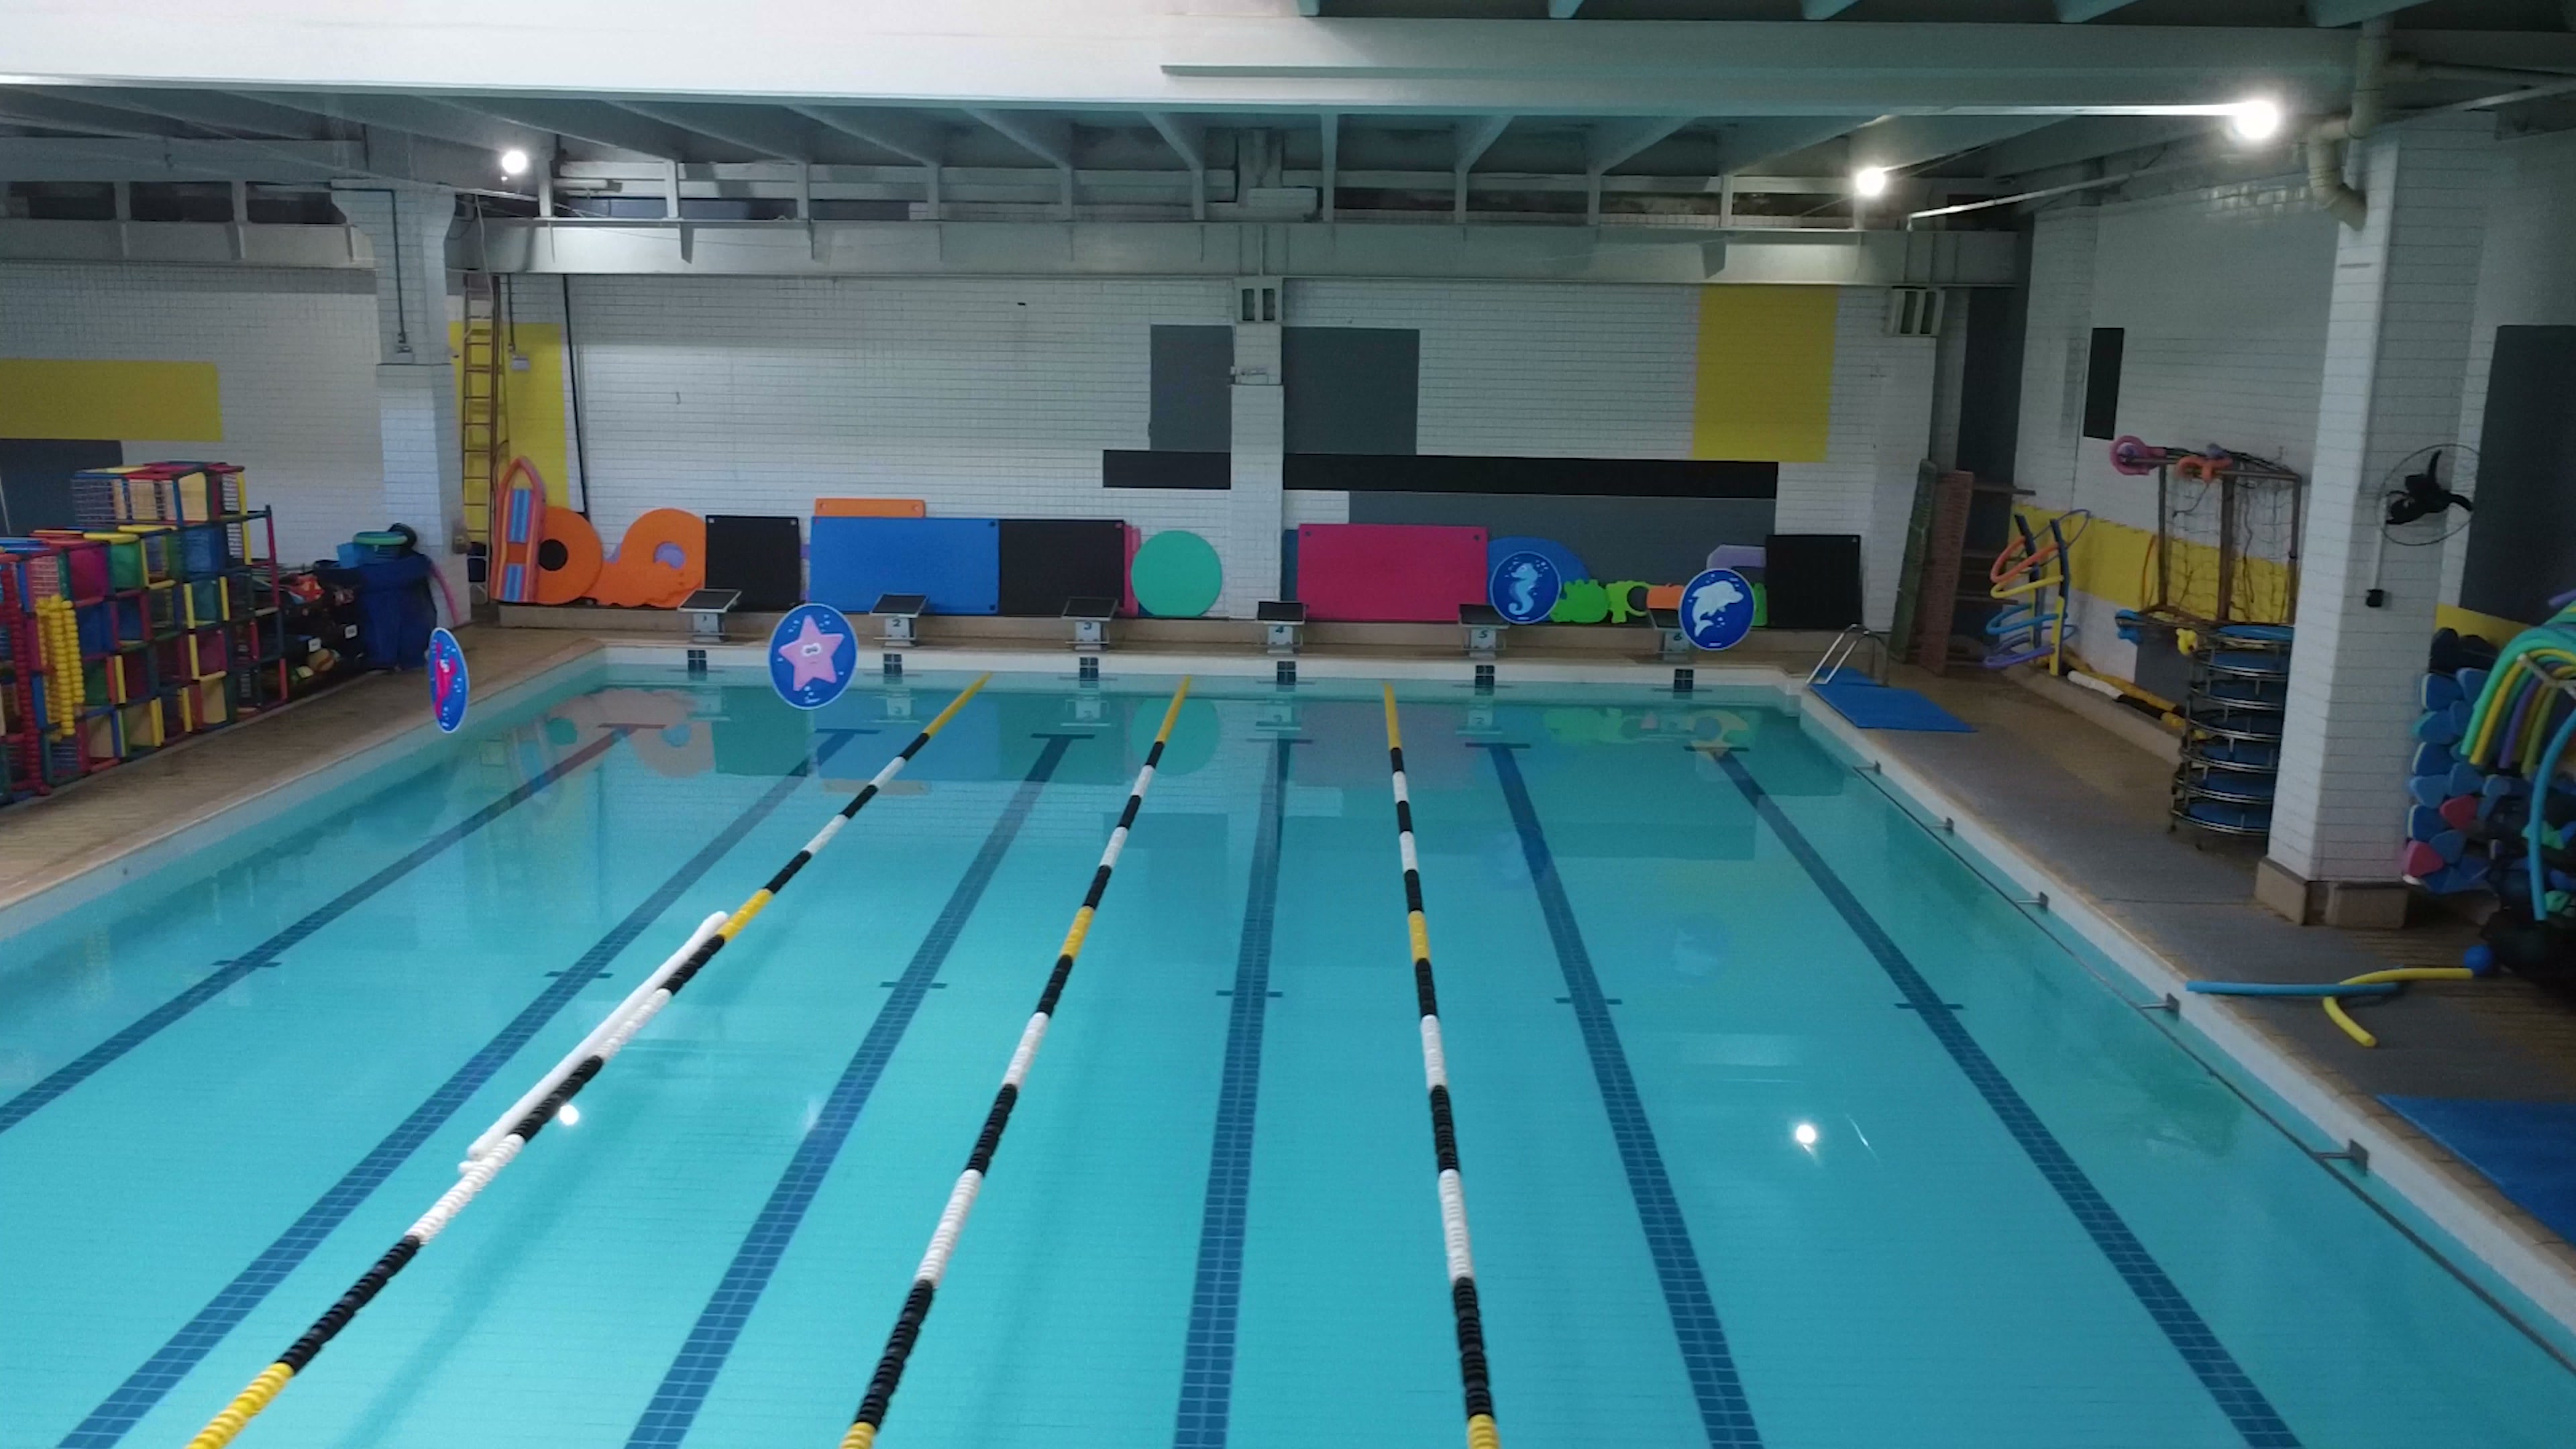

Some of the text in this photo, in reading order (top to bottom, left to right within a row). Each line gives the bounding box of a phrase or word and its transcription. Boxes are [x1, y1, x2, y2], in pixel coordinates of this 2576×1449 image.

[892, 618, 901, 627] 2
[1083, 621, 1092, 630] 3
[1275, 625, 1284, 634] 4
[1479, 629, 1488, 639] 5
[1673, 632, 1682, 641] 6
